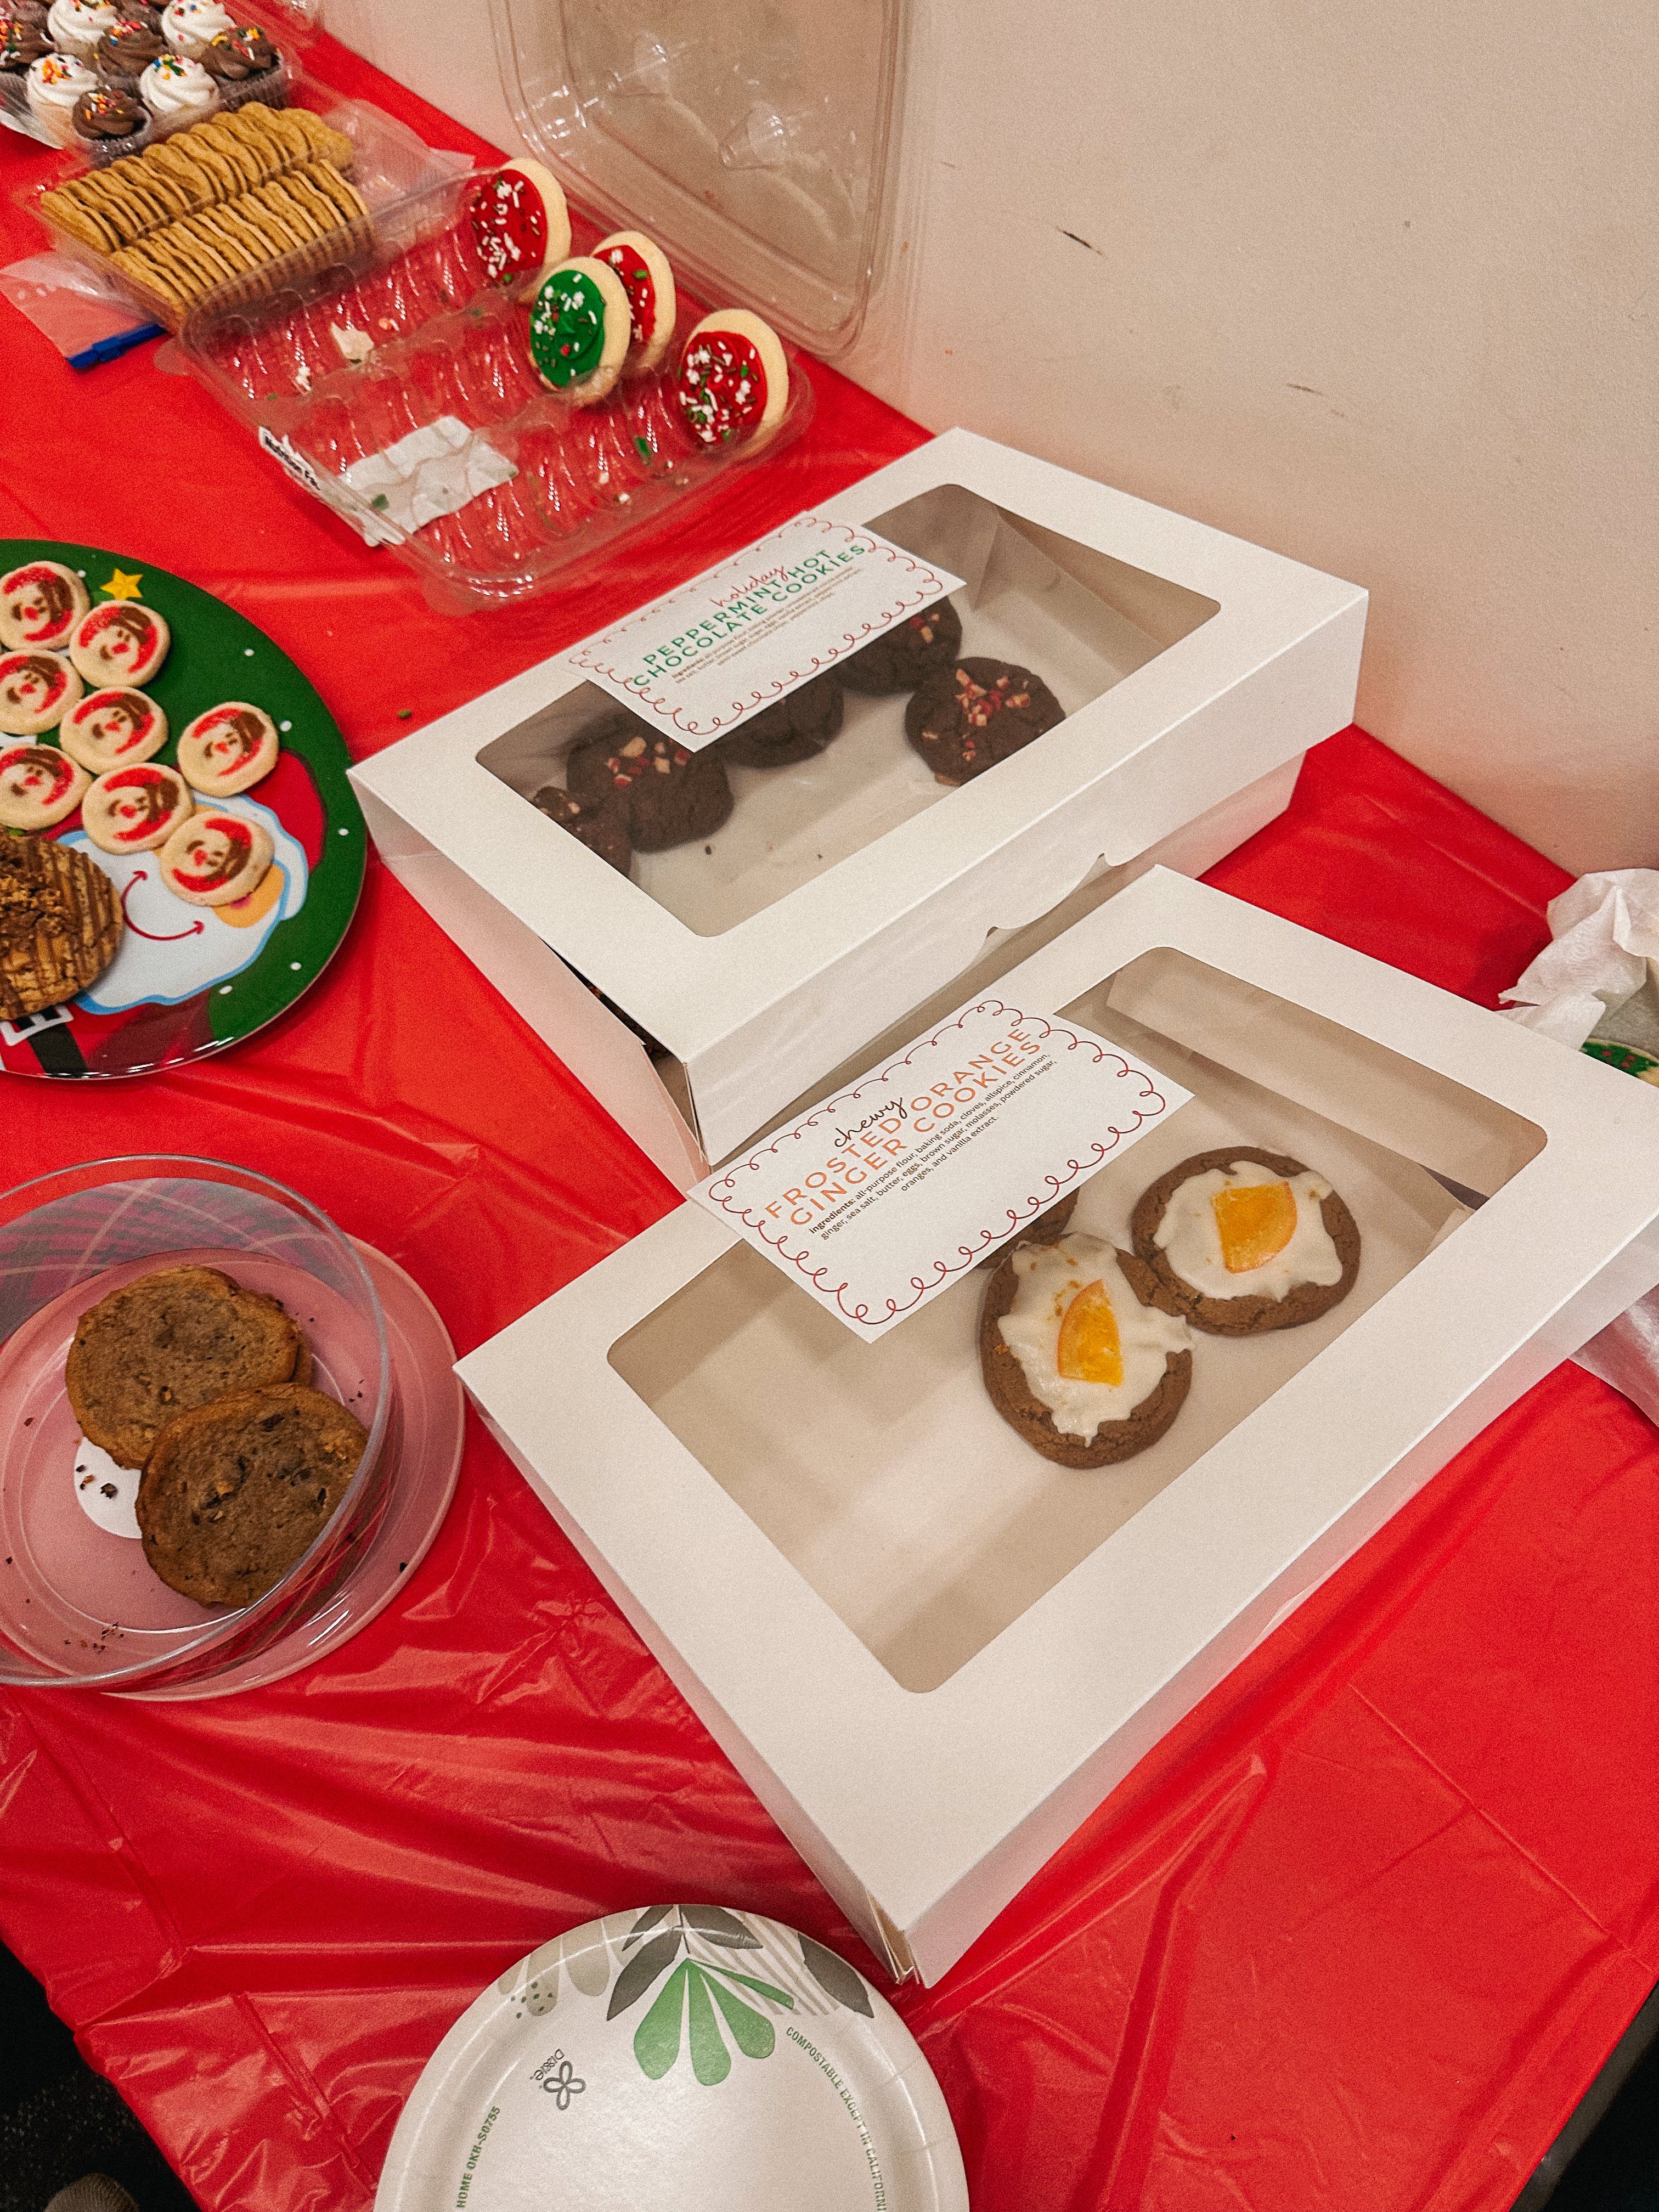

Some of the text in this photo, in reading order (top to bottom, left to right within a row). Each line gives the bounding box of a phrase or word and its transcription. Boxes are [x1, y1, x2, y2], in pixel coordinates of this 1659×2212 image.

[633, 604, 768, 686] CHOCOLATE
[771, 545, 864, 601] COOKIES
[641, 579, 782, 666] PEPPERMINT
[787, 550, 827, 578] HOT
[710, 566, 789, 607] holiday
[766, 1029, 1030, 1218] FROSTED ORANGE
[790, 1041, 1041, 1225] GINGER COOKIES
[808, 1198, 856, 1234] ingredients:
[854, 1166, 898, 1200] all-purpose
[895, 1152, 918, 1168] flour,
[913, 1133, 943, 1153] baking
[939, 1120, 962, 1135] soda,
[959, 1102, 987, 1120] cloves,
[984, 1080, 1015, 1102] allspice,
[820, 1059, 1057, 1240] ginger, sea salt, butter, eggs, brown sugar, molasses, powdered sugar,
[833, 1096, 908, 1148] chewy
[900, 1167, 934, 1192] oranges,
[931, 1153, 948, 1167] and
[945, 1136, 972, 1155] vanilla
[786, 2027, 844, 2090] COMPOSTABLE
[860, 2131, 872, 2146] IN
[456, 2106, 500, 2208] HOME OKH-S0755
